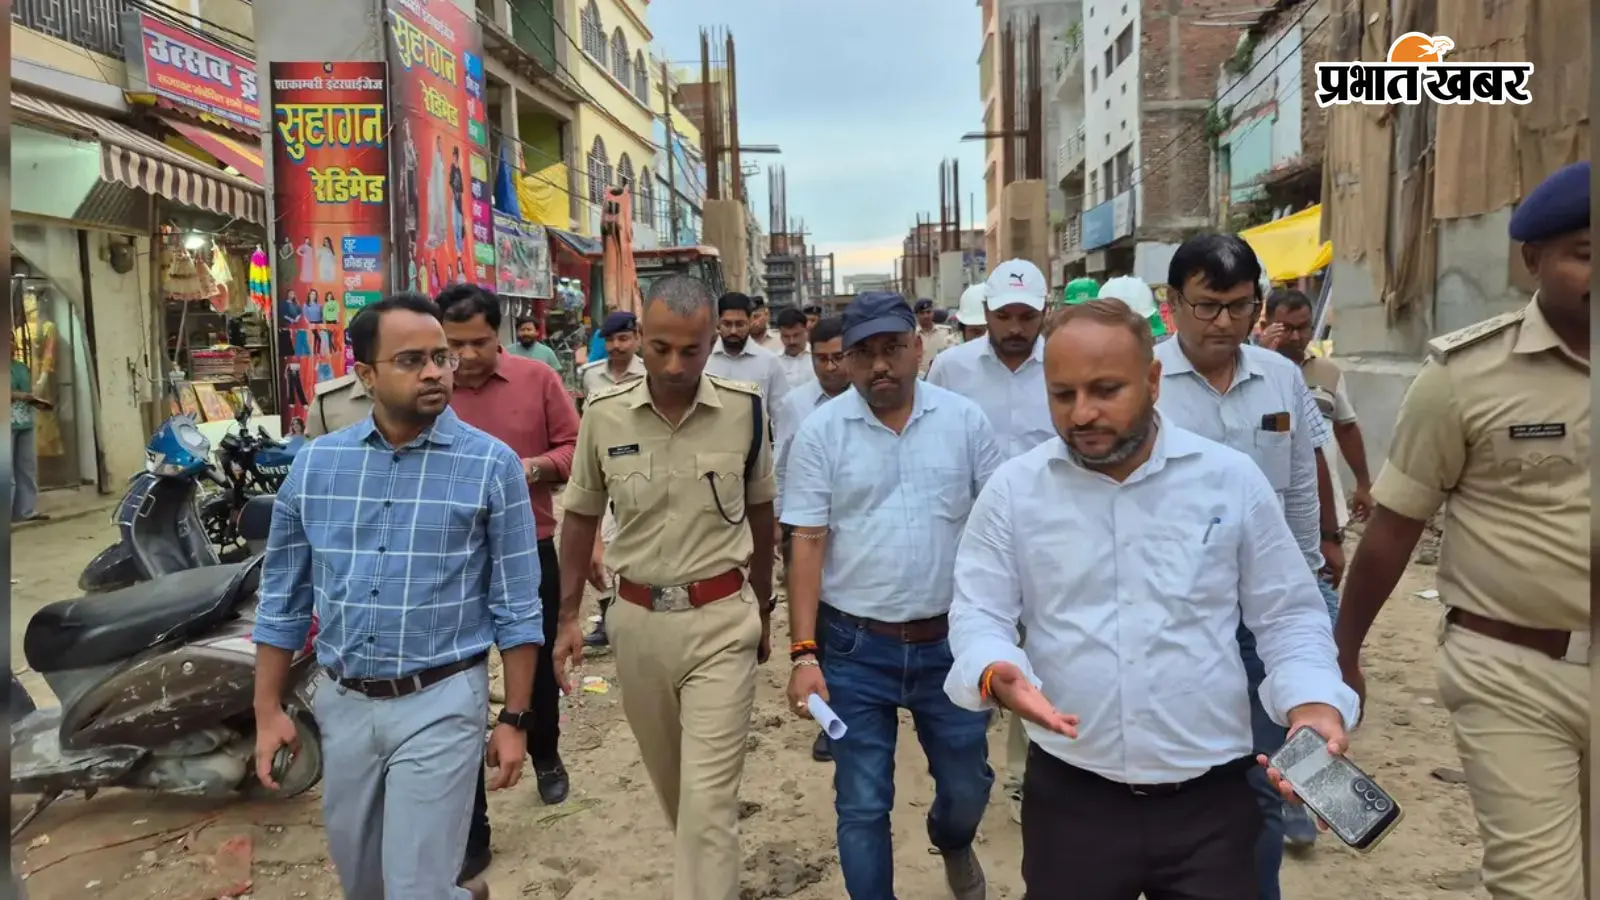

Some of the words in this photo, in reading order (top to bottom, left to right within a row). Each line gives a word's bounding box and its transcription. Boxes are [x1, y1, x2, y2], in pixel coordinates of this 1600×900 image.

[143, 27, 233, 89] उत्सव
[387, 8, 457, 88] सुहागन
[275, 103, 384, 162] सुहागन
[419, 79, 459, 128] रेडिमेड
[307, 166, 386, 204] रेडिमेड
